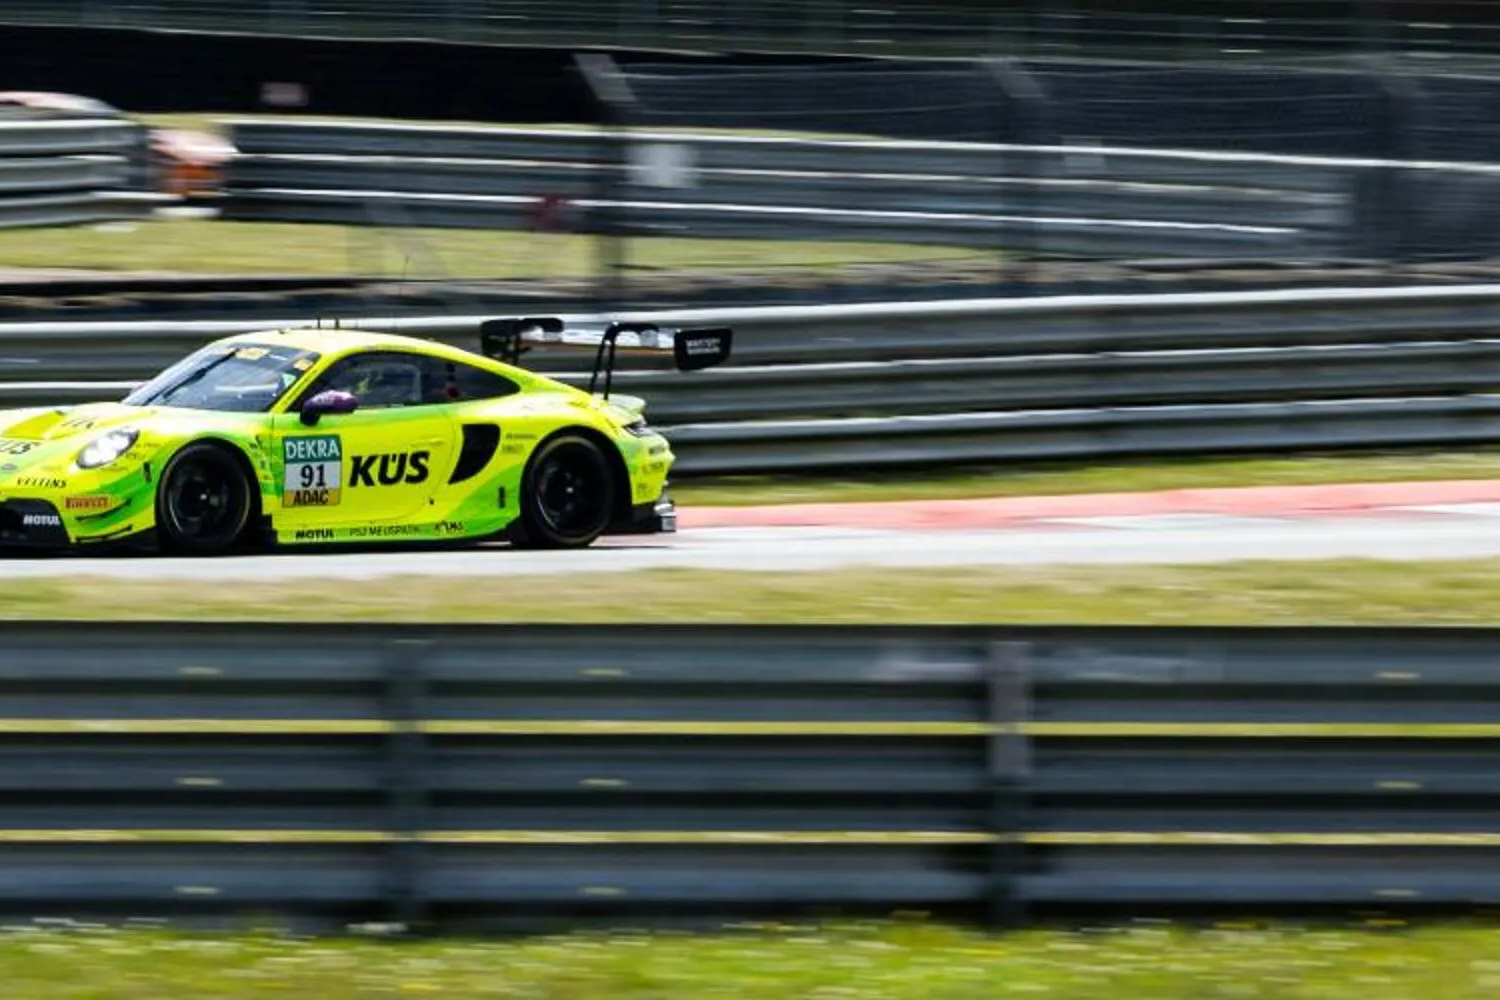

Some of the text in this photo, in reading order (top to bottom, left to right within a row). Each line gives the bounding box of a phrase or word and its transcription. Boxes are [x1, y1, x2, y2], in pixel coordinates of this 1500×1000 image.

[285, 438, 341, 460] DEKRA
[300, 463, 326, 489] 91
[348, 450, 431, 488] KÜS
[292, 488, 330, 505] ADAC
[23, 514, 61, 525] MOTUL
[295, 529, 335, 539] MOTUL
